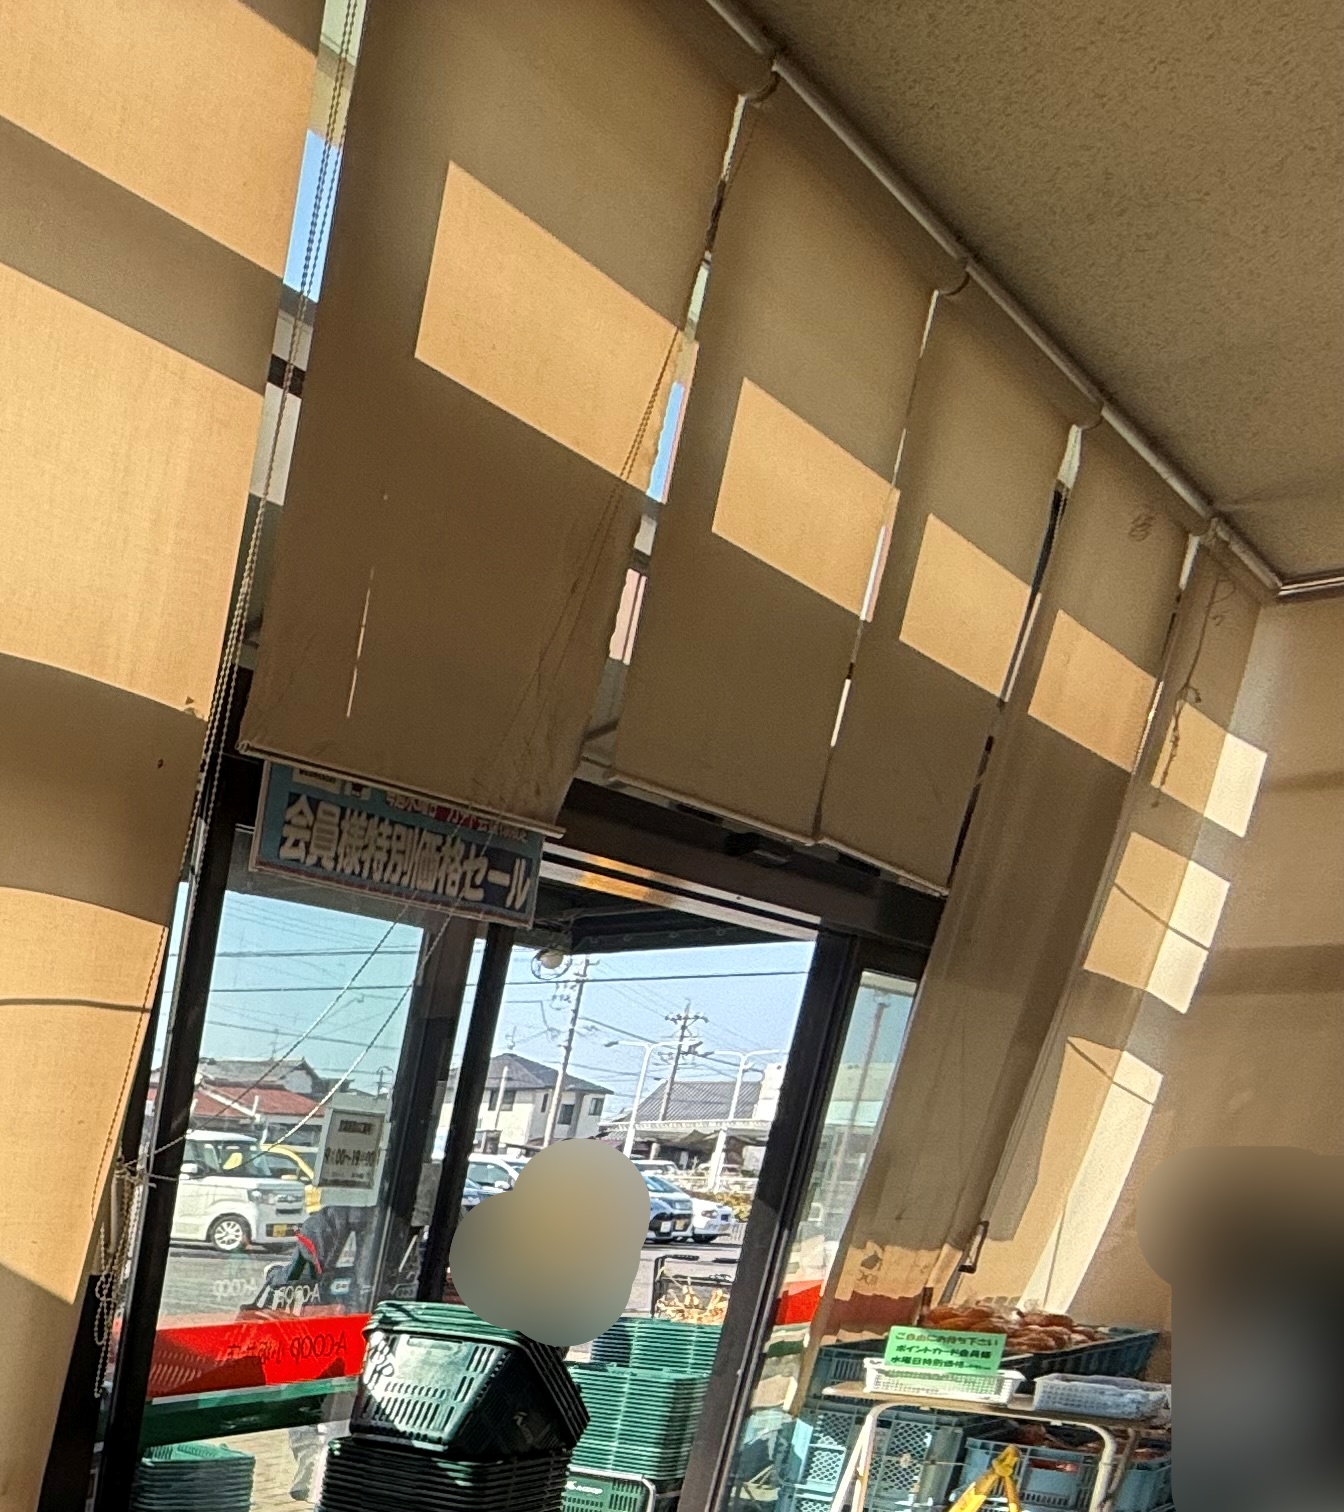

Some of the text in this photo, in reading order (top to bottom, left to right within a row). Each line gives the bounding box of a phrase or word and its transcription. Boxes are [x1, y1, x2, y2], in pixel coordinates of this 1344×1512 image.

[279, 793, 532, 911] 会員様特別価格セール
